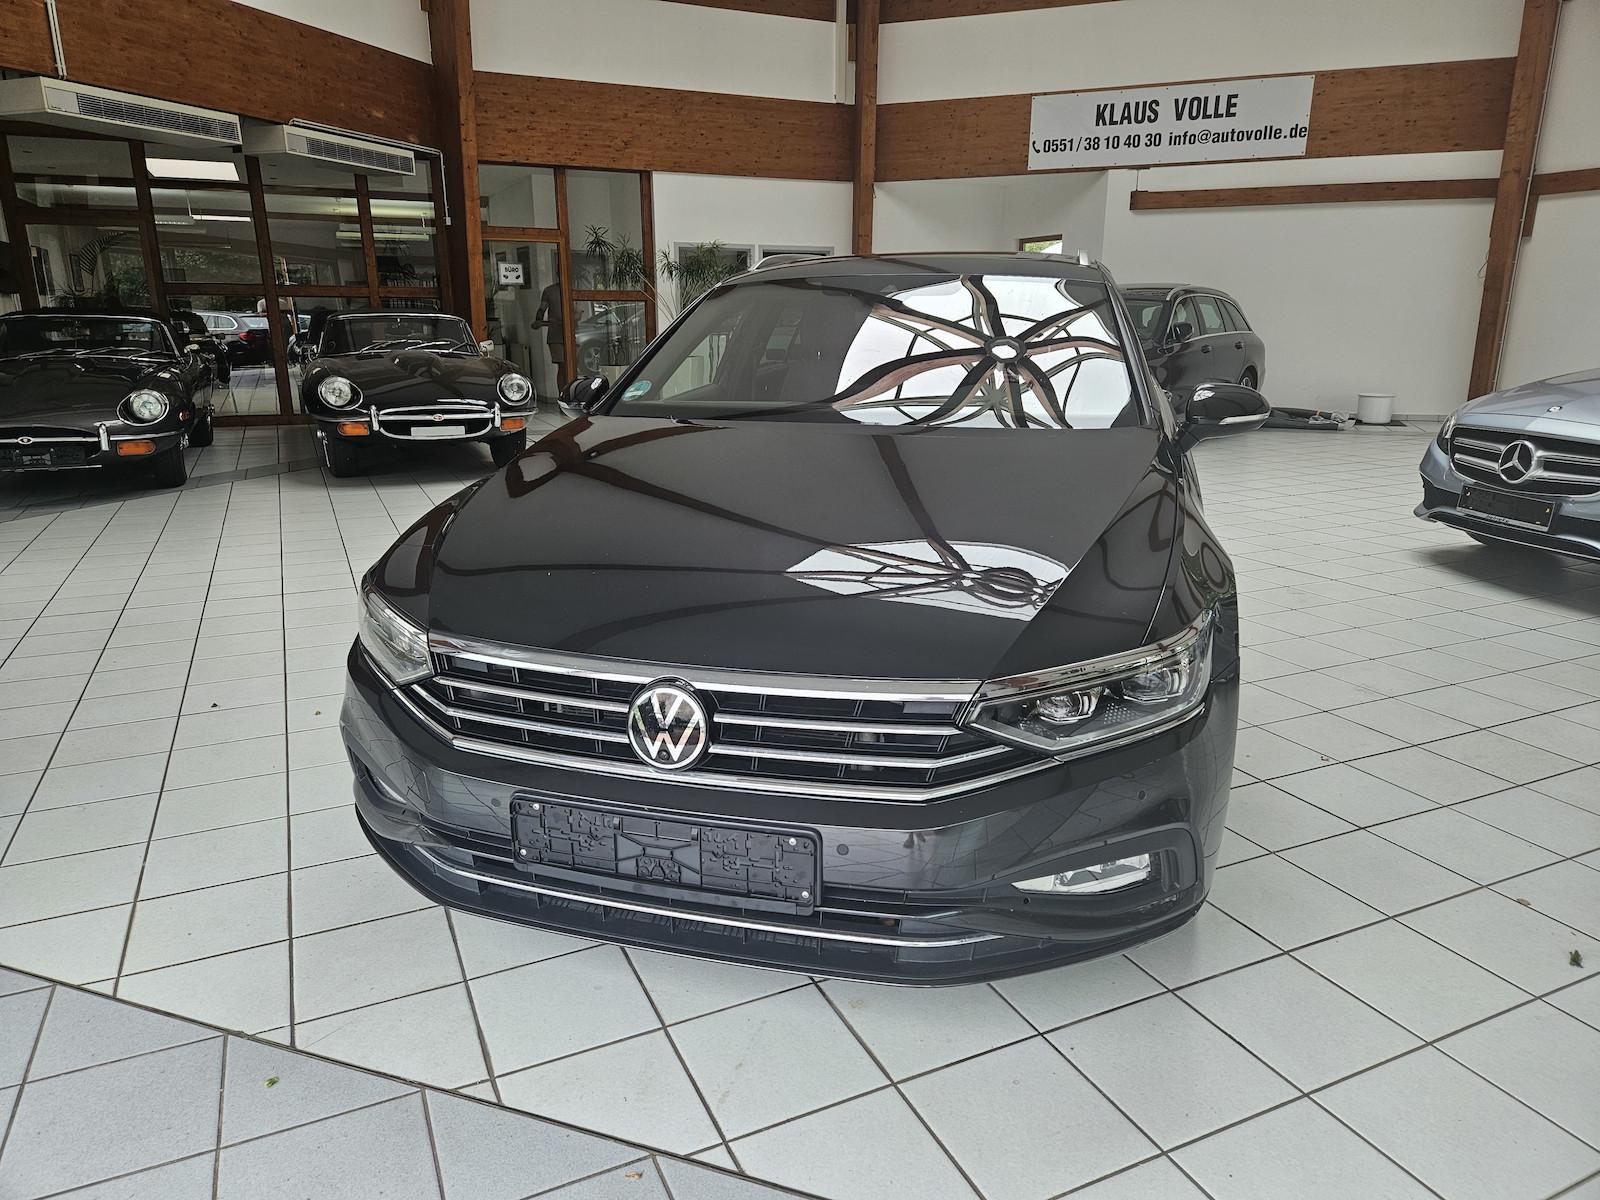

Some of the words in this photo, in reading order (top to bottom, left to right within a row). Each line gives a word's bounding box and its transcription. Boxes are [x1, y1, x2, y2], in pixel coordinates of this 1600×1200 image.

[1095, 99, 1160, 127] KLAUS
[1174, 93, 1239, 121] VOLLE
[1104, 135, 1120, 150] 10
[1123, 134, 1141, 149] 40
[1144, 132, 1162, 147] 30
[1168, 123, 1308, 147] info@autovolle.de
